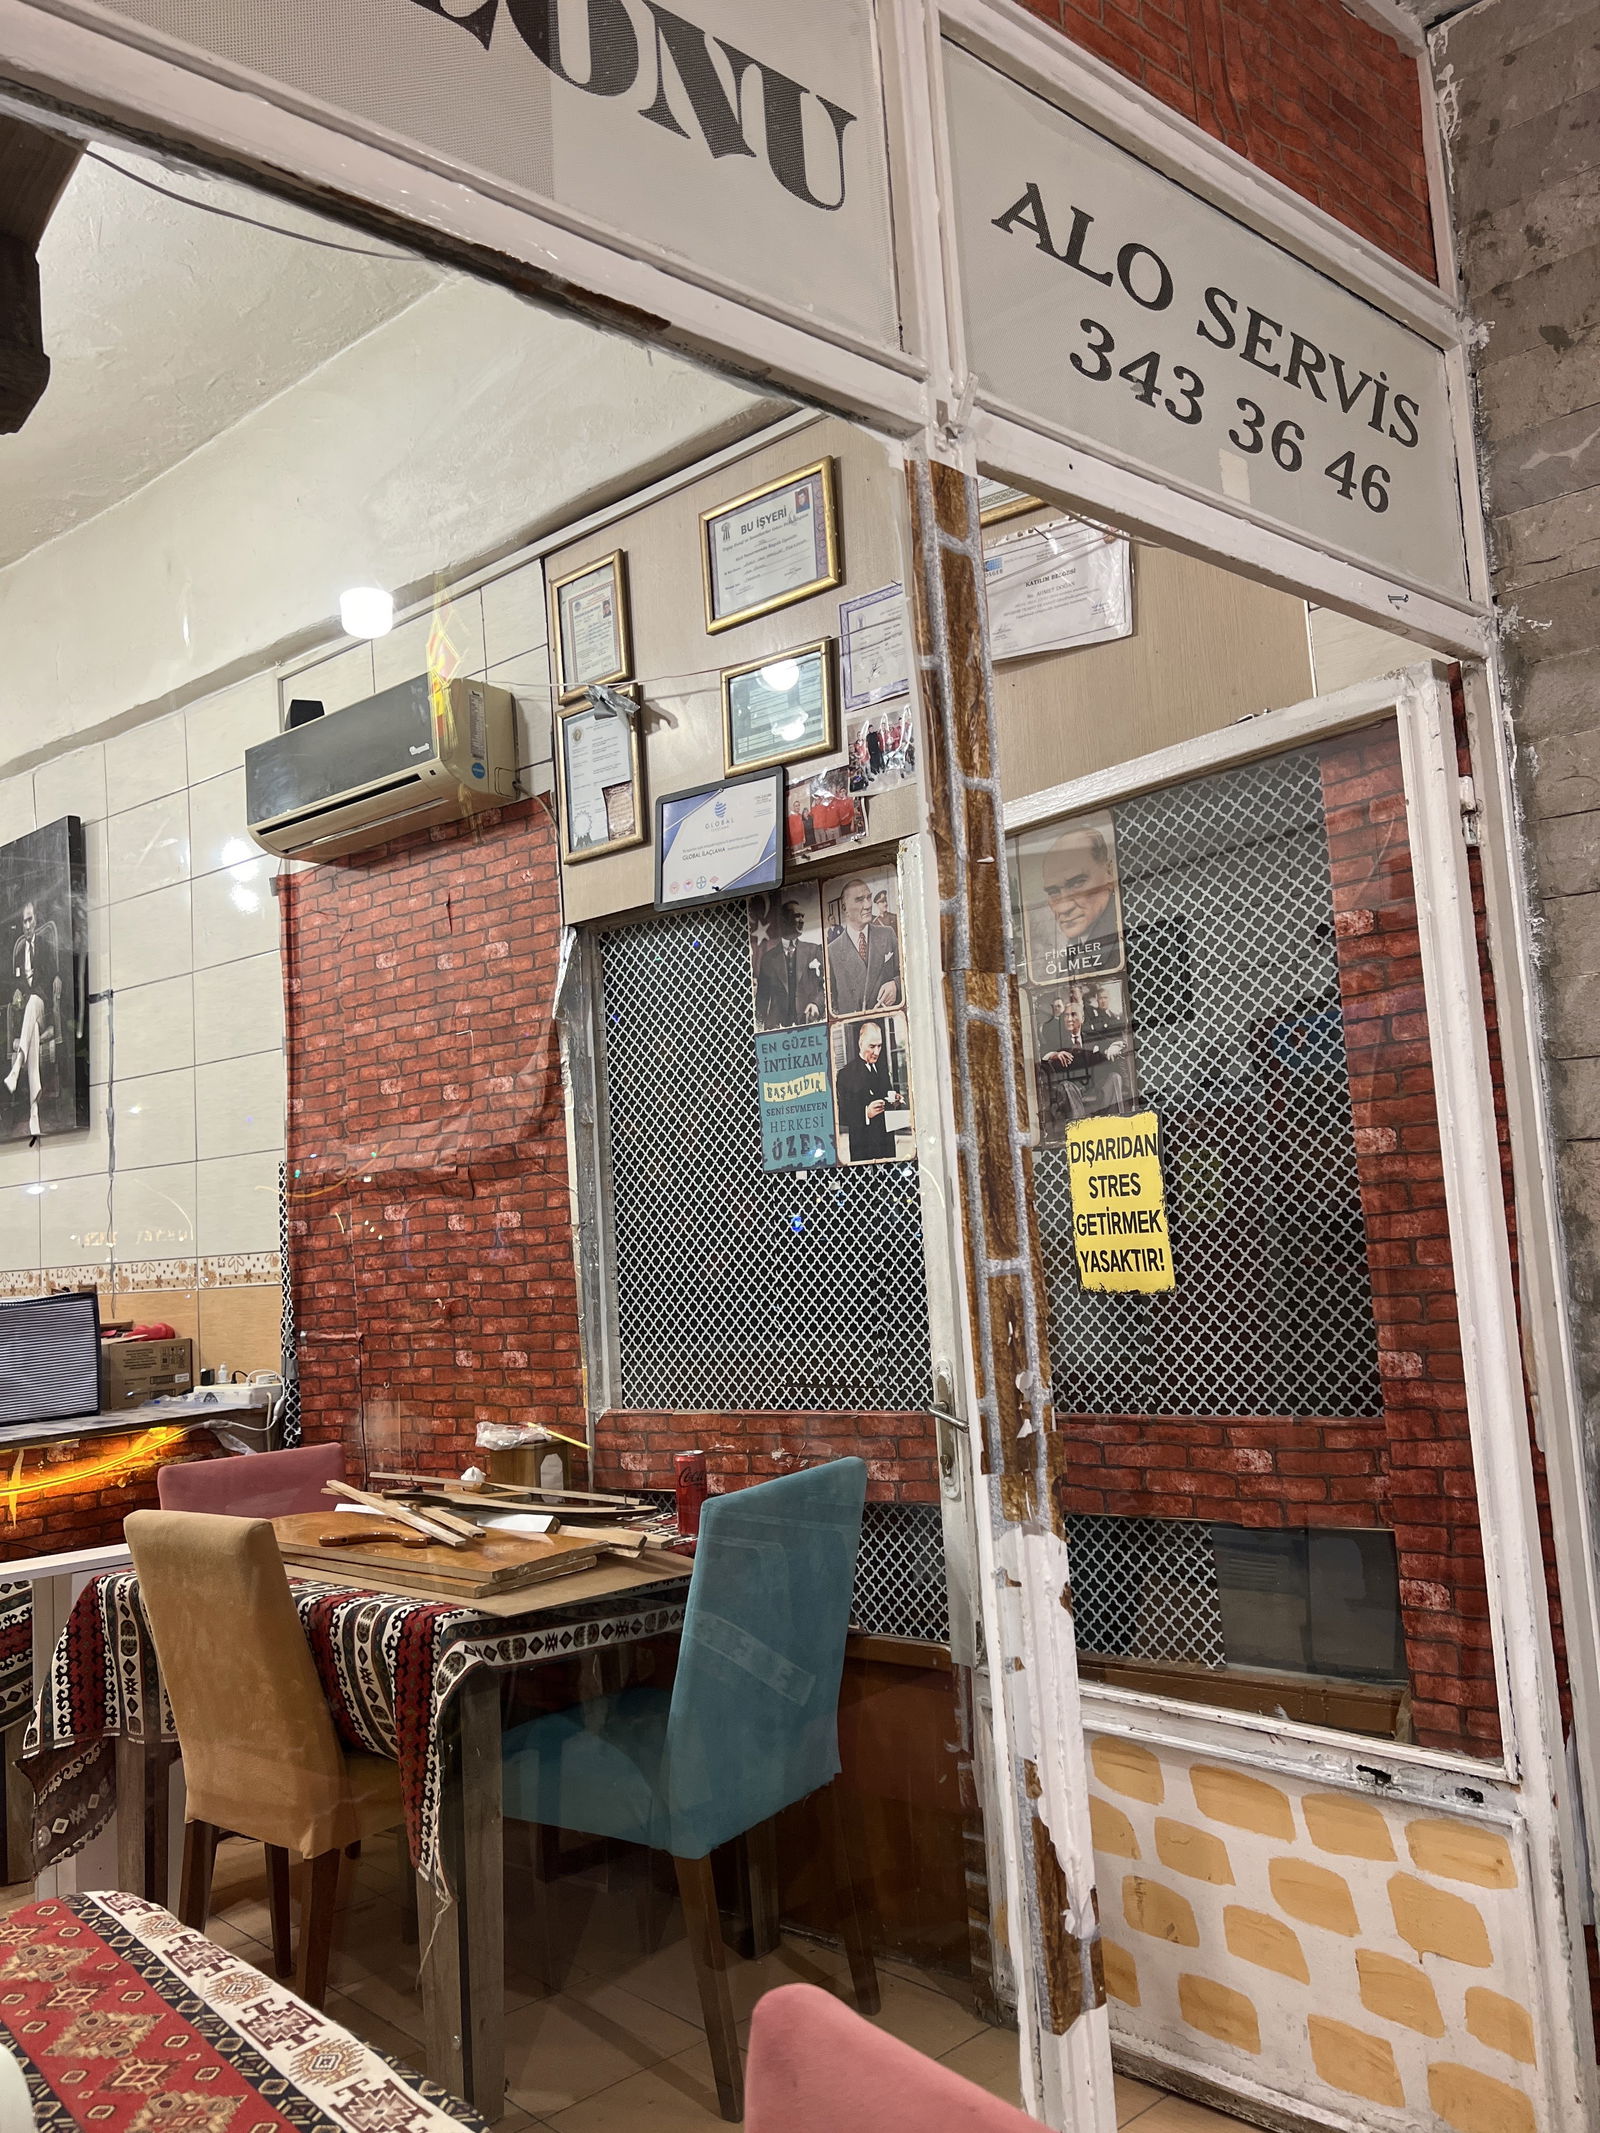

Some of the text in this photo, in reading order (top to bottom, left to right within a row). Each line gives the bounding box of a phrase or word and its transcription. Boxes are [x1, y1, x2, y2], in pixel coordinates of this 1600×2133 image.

[409, 0, 857, 211] ONU
[991, 182, 1420, 448] ALO SERVİS
[1069, 318, 1391, 513] 343 36 46
[740, 521, 754, 535] BU
[756, 505, 787, 530] İŞYERİ
[705, 819, 734, 830] GLOBAL
[1046, 954, 1103, 975] ÖLMEZ
[761, 1035, 823, 1054] EN GÜZEL
[764, 1052, 824, 1073] İNTİKAM
[766, 1101, 828, 1117] SENİ SEVMEYEN
[770, 1112, 825, 1134] HERKESİ
[1070, 1133, 1158, 1168] DIŞARIDAN
[1088, 1172, 1141, 1199] STRES
[1076, 1207, 1163, 1236] GETİRMEK
[1079, 1247, 1165, 1273] YASAKTIR!
